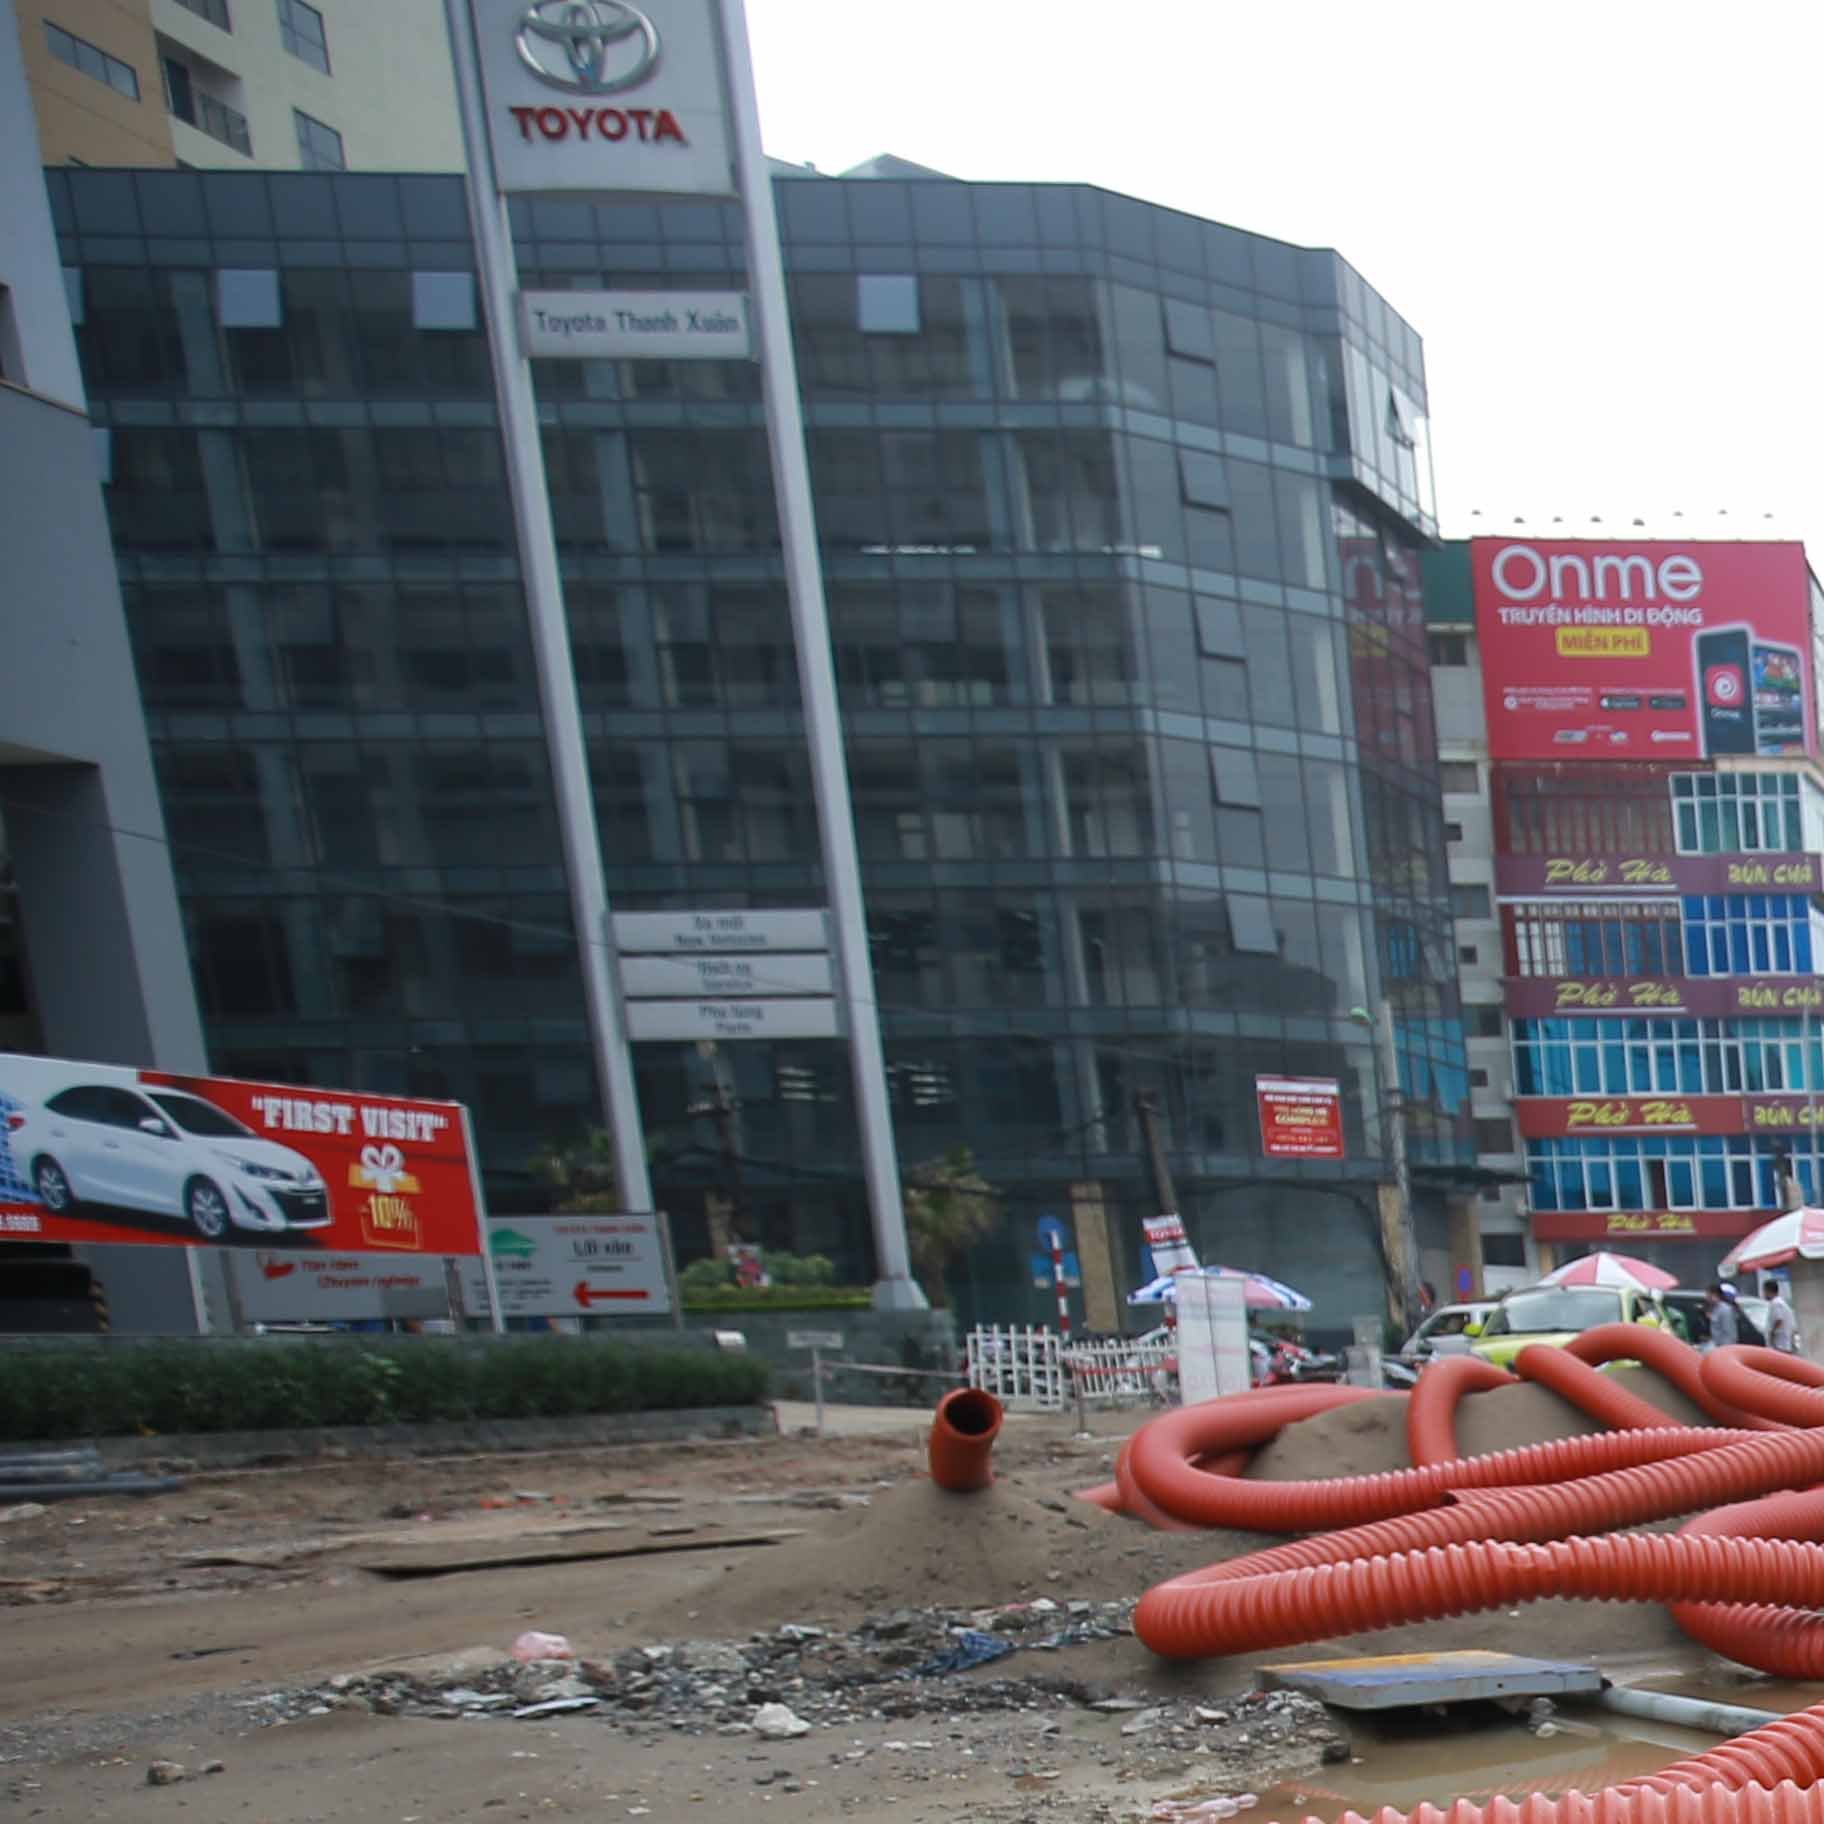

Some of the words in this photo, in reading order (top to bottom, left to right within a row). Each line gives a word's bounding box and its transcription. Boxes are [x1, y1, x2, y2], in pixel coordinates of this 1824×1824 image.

[509, 106, 688, 146] TOYOTA
[533, 311, 607, 337] Toyota
[614, 310, 677, 332] Thanh
[685, 308, 739, 332] Xuân
[1492, 544, 1703, 602] Onme
[1625, 607, 1643, 624] DI
[1647, 604, 1703, 628] ĐỘNG
